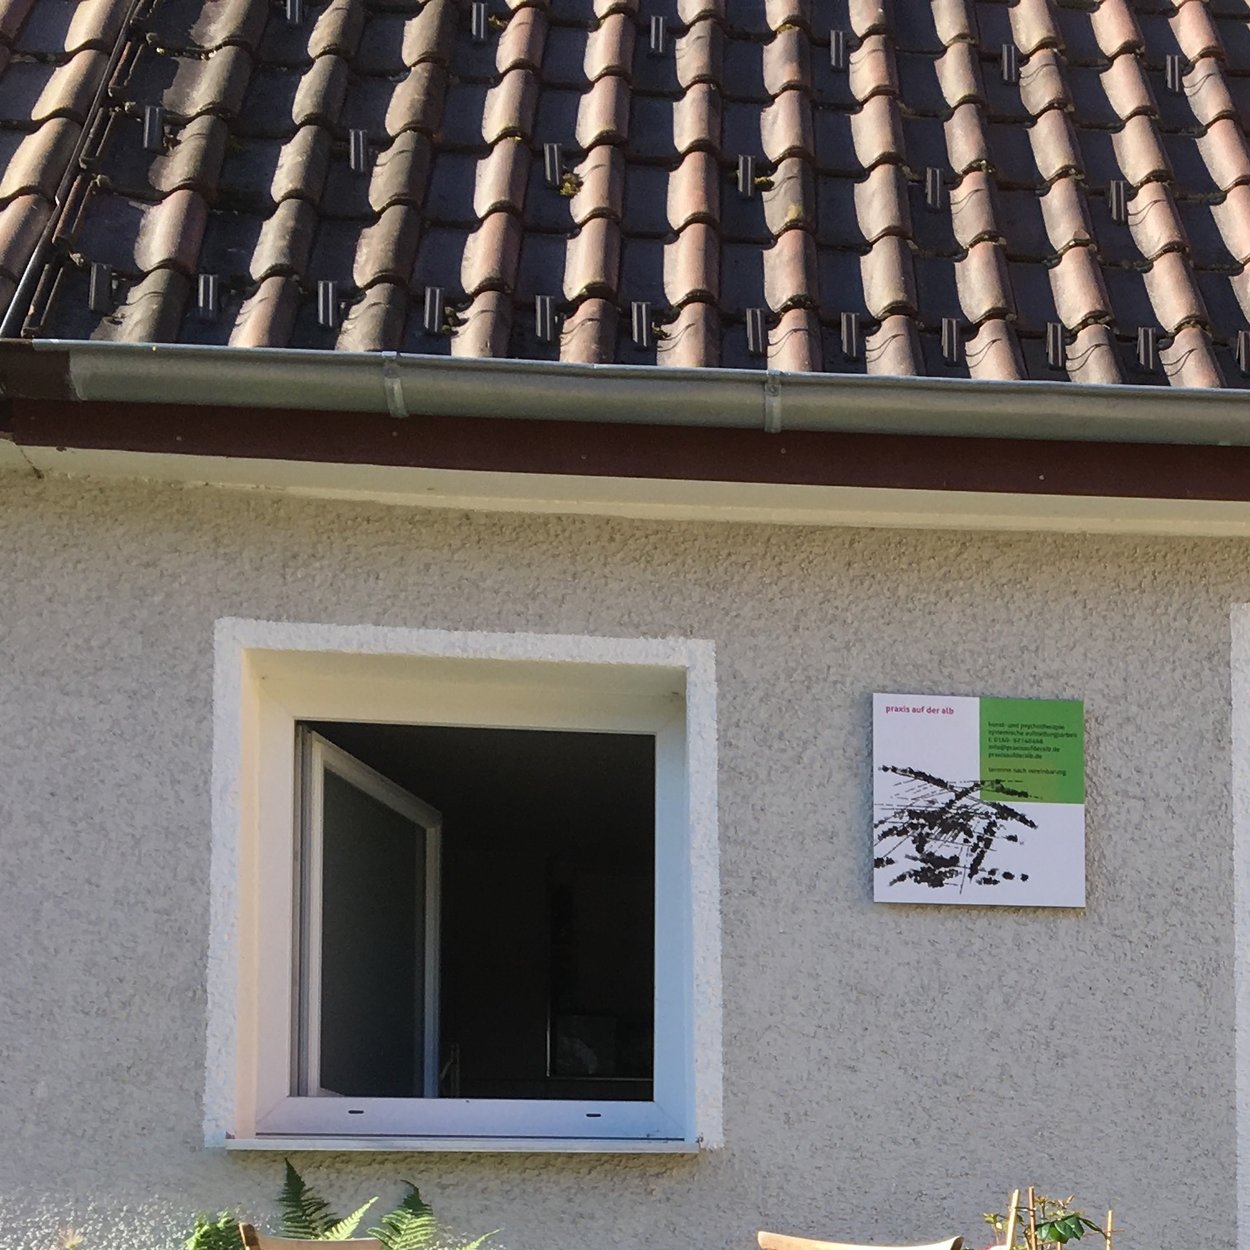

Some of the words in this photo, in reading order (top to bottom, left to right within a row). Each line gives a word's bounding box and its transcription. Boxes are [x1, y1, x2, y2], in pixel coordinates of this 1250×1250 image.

[885, 705, 910, 714] praxis
[911, 705, 925, 713] auf
[926, 705, 940, 714] der
[941, 706, 954, 714] alb
